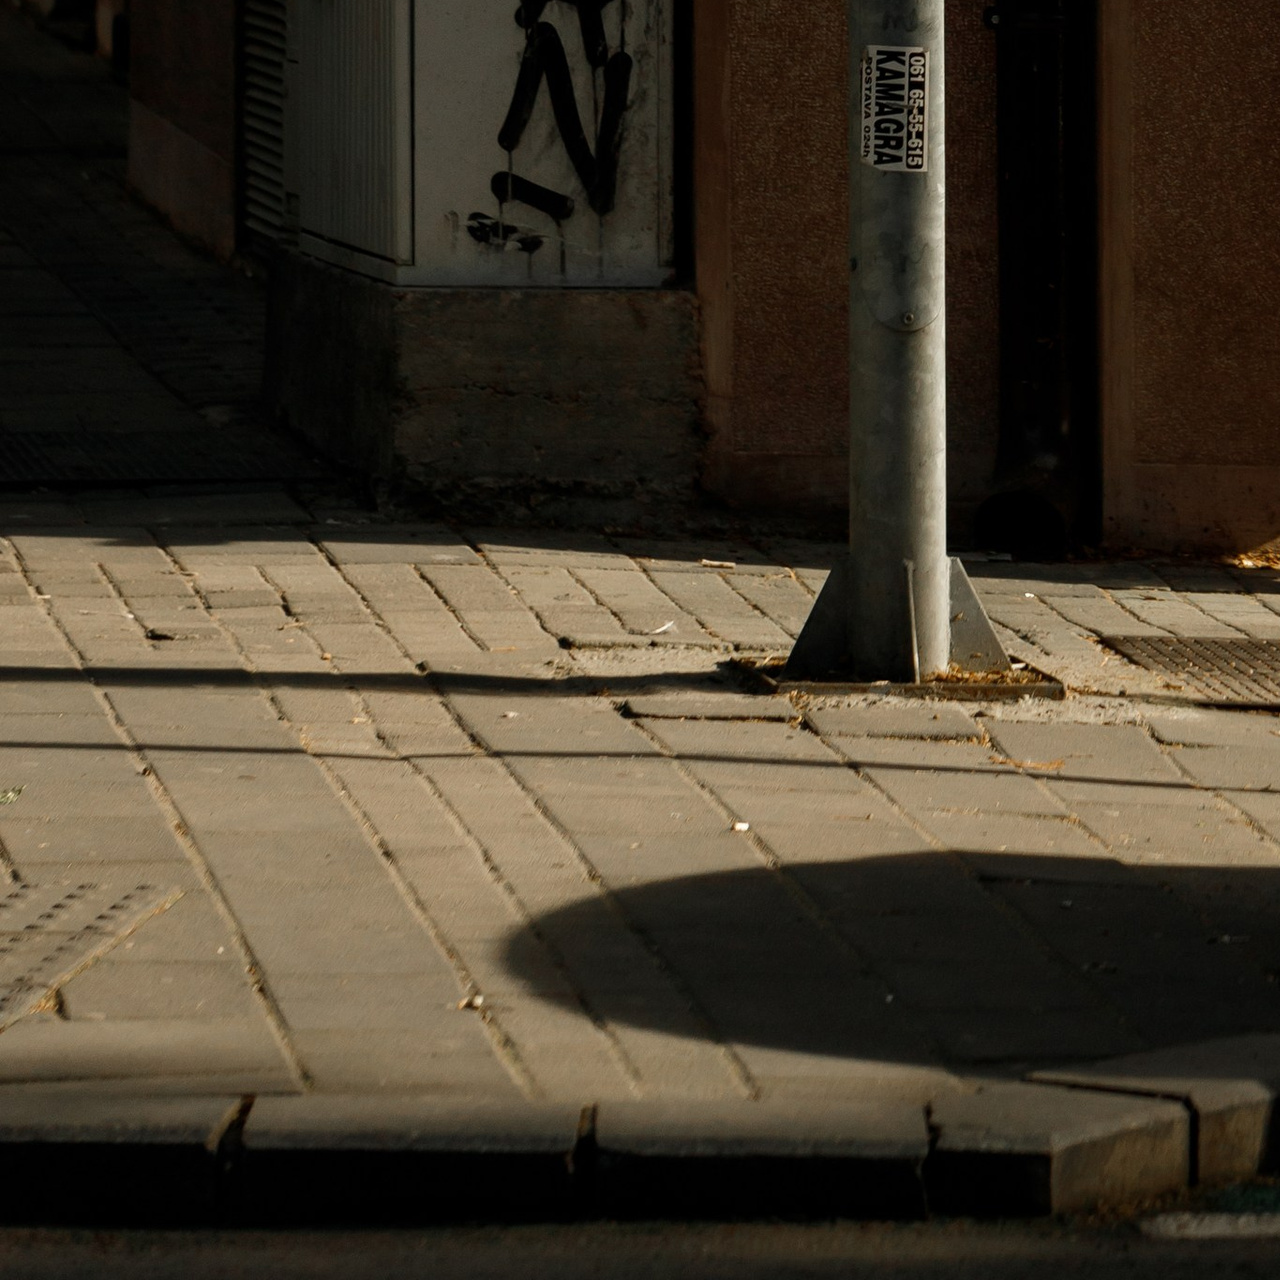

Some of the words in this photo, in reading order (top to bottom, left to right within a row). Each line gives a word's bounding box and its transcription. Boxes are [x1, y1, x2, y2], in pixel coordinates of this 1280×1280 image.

[863, 57, 873, 119] DOSTAVA
[909, 55, 925, 82] 061
[873, 50, 906, 166] KAMAGRA
[907, 88, 924, 167] 65-55-615
[862, 126, 871, 158] 024h
